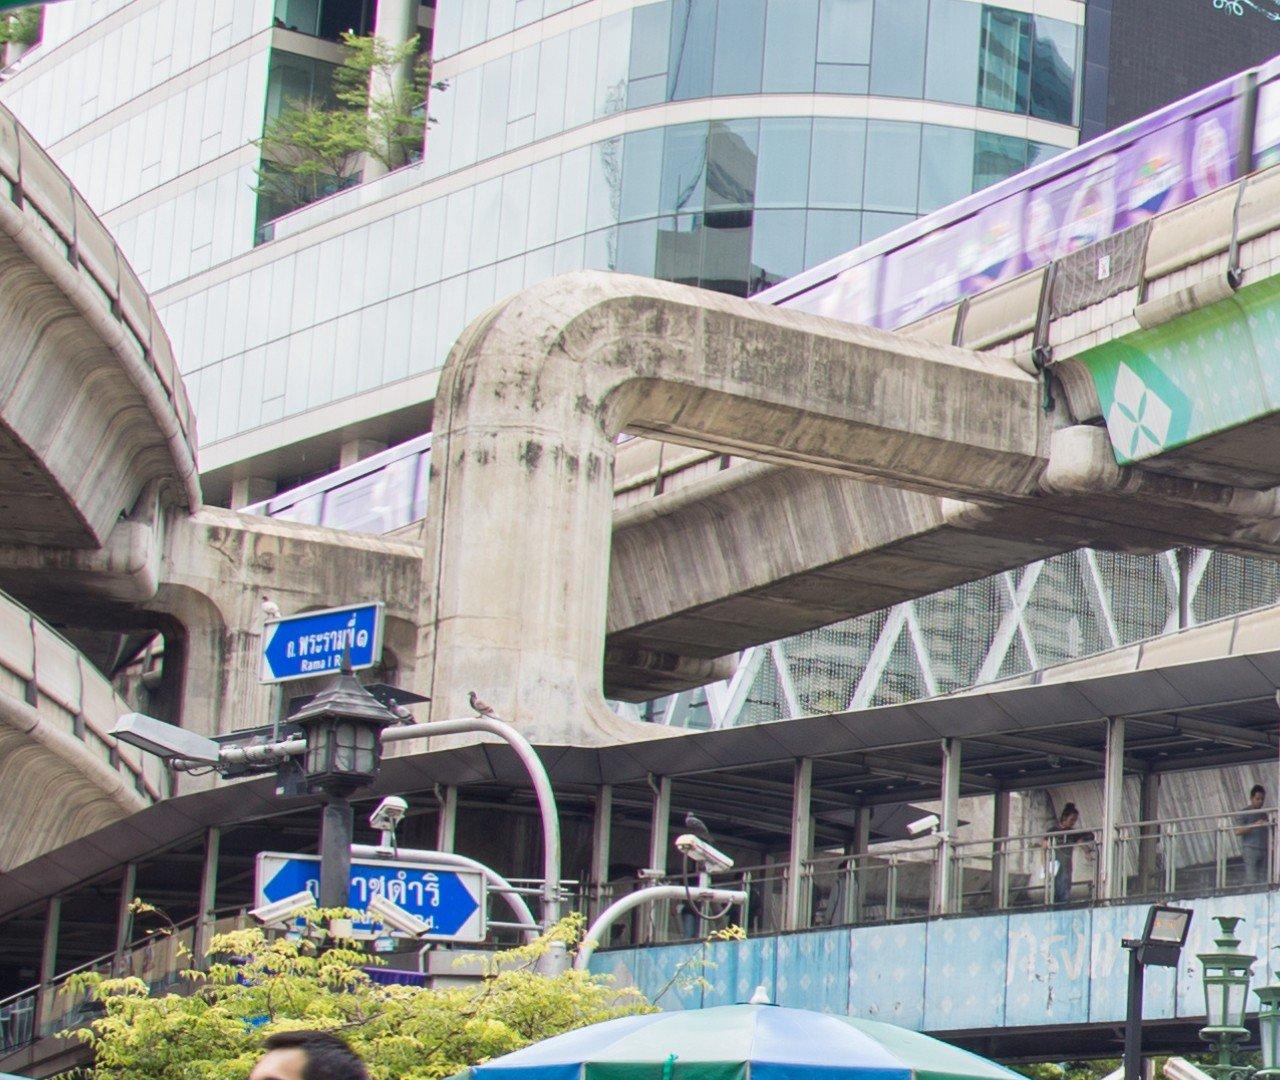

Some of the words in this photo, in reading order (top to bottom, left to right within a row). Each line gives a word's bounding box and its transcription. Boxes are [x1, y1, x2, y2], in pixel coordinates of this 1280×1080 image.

[301, 658, 326, 672] Rama
[351, 871, 441, 908] าชดำริ
